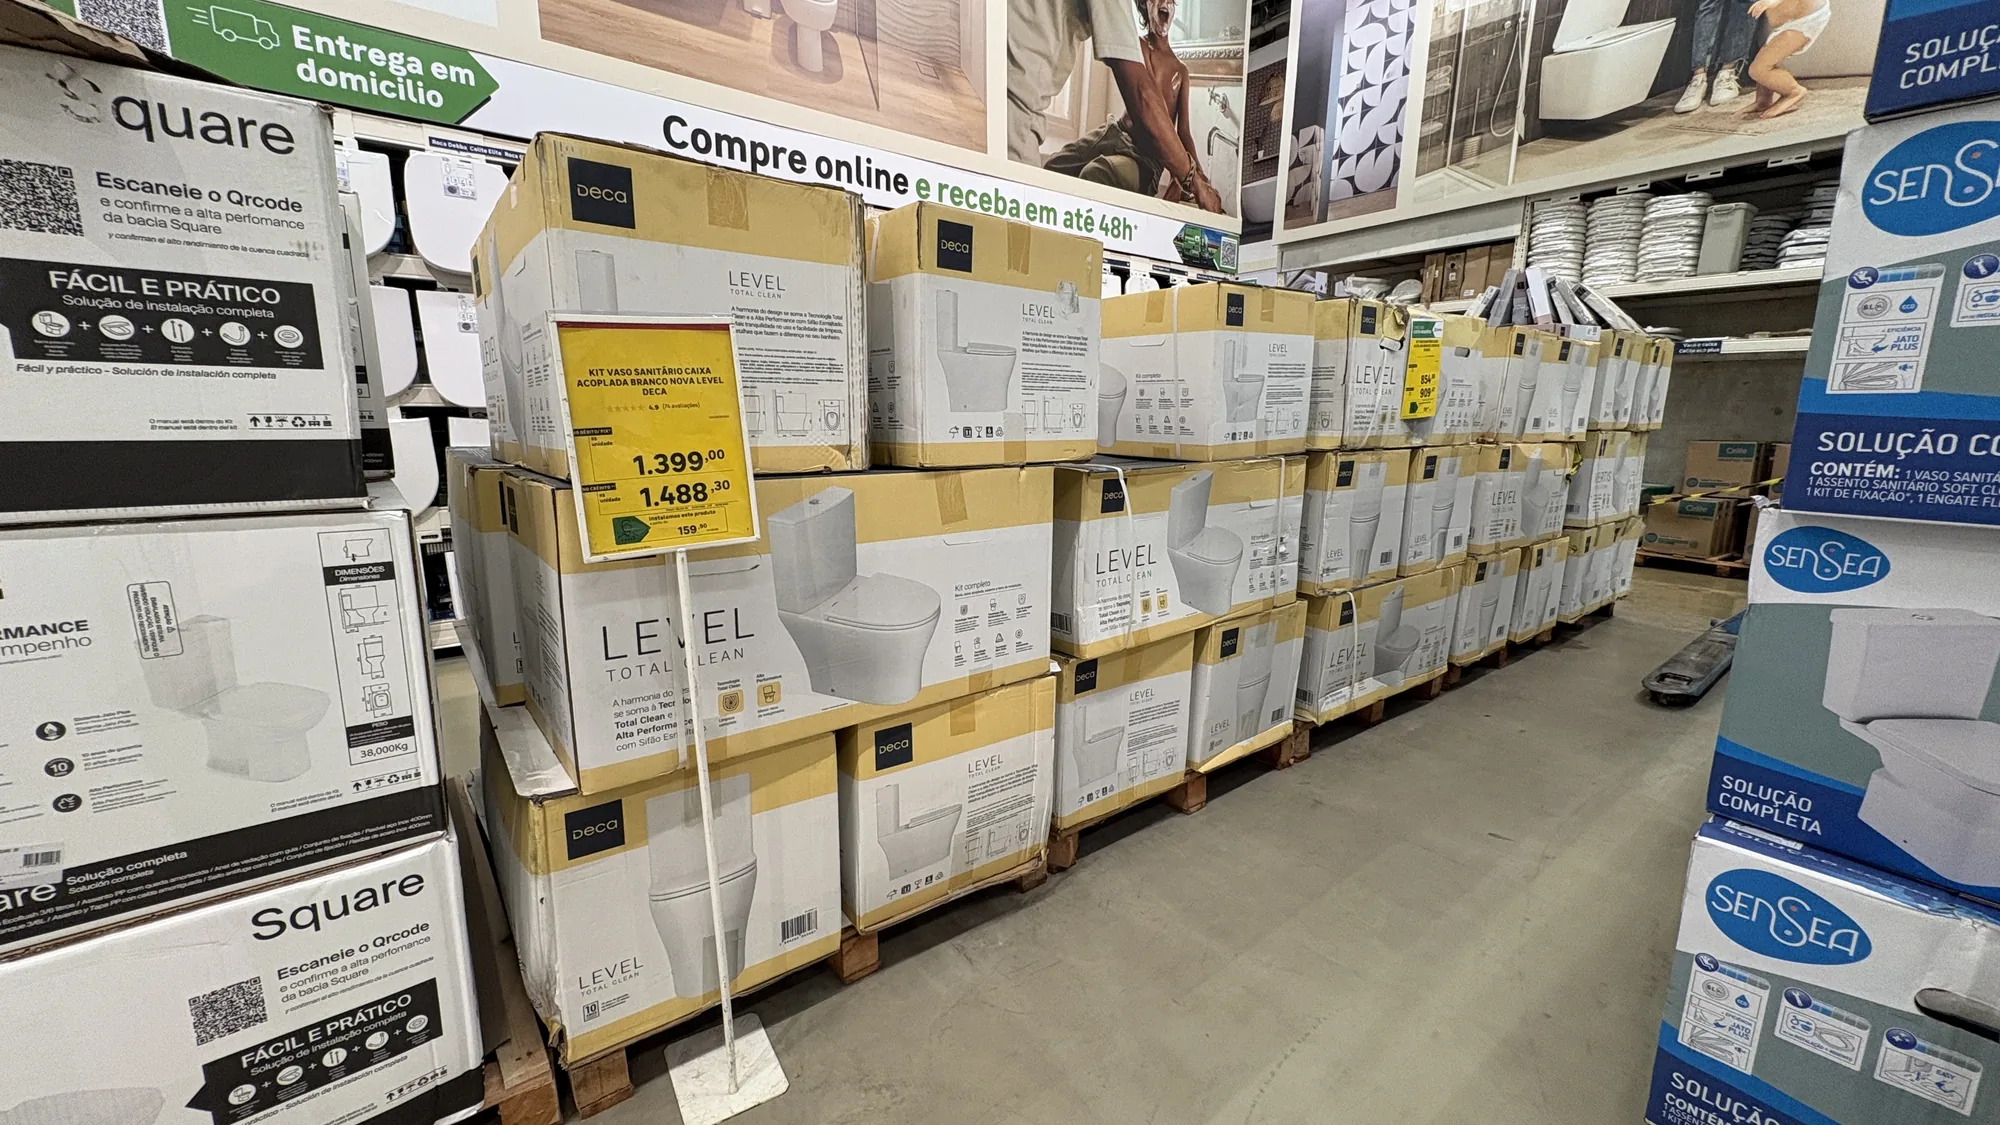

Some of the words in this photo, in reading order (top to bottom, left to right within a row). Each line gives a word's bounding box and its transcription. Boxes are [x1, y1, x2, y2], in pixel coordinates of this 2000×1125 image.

[1905, 24, 2000, 64] SOLUÇ
[291, 25, 424, 77] Entrega
[430, 61, 476, 87] em
[1900, 52, 2000, 89] COMPL
[432, 139, 447, 147] Roca
[505, 151, 519, 159] Roca
[662, 114, 807, 174] Compre
[815, 155, 910, 195] online
[915, 178, 931, 200] e
[938, 178, 1020, 220] receba
[1025, 201, 1058, 227] em
[1063, 207, 1095, 234] até
[96, 171, 203, 200] Escaneie
[208, 190, 222, 202] o
[227, 190, 303, 213] Qrcode
[576, 182, 628, 206] Deca
[100, 197, 111, 207] e
[114, 198, 181, 216] confirme
[184, 207, 194, 217] a
[196, 208, 222, 221] alta
[225, 211, 305, 230] perfomance
[103, 212, 123, 224] da
[127, 213, 168, 229] bacia
[170, 218, 222, 235] Square
[48, 269, 136, 296] FÁCIL
[140, 278, 160, 297] E
[166, 280, 281, 305] PRÁTICO
[729, 270, 786, 291] LEVEL
[730, 288, 754, 297] TOTAL
[758, 291, 782, 299] CLEAN
[62, 294, 122, 311] Solução
[125, 300, 144, 312] de
[146, 301, 214, 316] instalação
[216, 306, 275, 320] completa
[808, 312, 832, 320] Tecnologia
[1022, 303, 1055, 319] LEVEL
[1269, 343, 1288, 353] LEVEL
[1890, 343, 1918, 351] PLUS
[1894, 335, 1919, 343] JATO
[16, 363, 45, 374] Fácil
[46, 366, 54, 376] y
[56, 365, 103, 378] práctico
[112, 366, 159, 378] Solución
[160, 368, 175, 378] de
[176, 369, 231, 379] instalación
[232, 371, 277, 381] completa
[588, 368, 605, 377] KIT
[606, 367, 633, 376] VASO
[634, 365, 684, 376] SANITÁRIO
[685, 367, 712, 375] CAIXA
[577, 378, 629, 387] ACOPLADA
[630, 377, 669, 386] BRANCO
[669, 377, 695, 385] NOVA
[696, 376, 724, 385] LEVEL
[642, 387, 668, 396] DECA
[1817, 428, 1958, 460] SOLUÇÃO
[1810, 460, 1901, 479] CONTÉM:
[1905, 470, 1911, 480] 1
[1914, 470, 1950, 482] VASO
[1808, 476, 1813, 485] 1
[1816, 477, 1870, 489] ASSENTO
[1872, 479, 1940, 492] SANITÁRIO
[1941, 482, 1977, 495] SOFT
[1492, 490, 1517, 506] LEVEL
[1806, 486, 1811, 495] 1
[1813, 487, 1832, 498] KIT
[1834, 488, 1850, 499] DE
[1917, 494, 1923, 503] 1
[1925, 493, 1979, 506] ENGATE
[694, 509, 716, 517] produto
[1096, 544, 1157, 575] LEVEL
[1326, 548, 1343, 559] LEVEL
[1768, 540, 1882, 581] SENSEA
[335, 566, 386, 576] DIMENSÕES
[339, 574, 380, 583] Dimensiones
[1096, 577, 1123, 588] TOTAL
[1126, 570, 1152, 582] CEAN
[955, 584, 963, 592] Kit
[964, 580, 991, 590] completo
[605, 660, 673, 683] TOTAL
[612, 699, 620, 708] A
[621, 693, 661, 707] harmonia
[662, 689, 674, 698] do
[1130, 688, 1155, 702] LEVEL
[614, 718, 638, 730] Total
[640, 713, 666, 725] Clean
[667, 711, 673, 719] e
[1210, 719, 1230, 734] LEVEL
[616, 731, 635, 741] Alta
[360, 743, 409, 759] 38,000Kg
[50, 762, 68, 774] 10
[968, 754, 1003, 773] LEVEL
[1721, 775, 1812, 812] SOLUÇÃO
[1718, 792, 1822, 836] COMPLETA
[571, 818, 619, 842] Deca
[66, 867, 124, 886] Solução
[126, 851, 188, 872] completa
[68, 879, 110, 895] Solución
[111, 869, 154, 886] completa
[251, 873, 425, 941] Square
[1711, 884, 1860, 957] SENSEA
[277, 948, 355, 981] Escaneie
[358, 943, 369, 953] o
[373, 922, 430, 948] Qrcode
[579, 957, 644, 990] LEVEL
[581, 984, 608, 997] TOTAL
[612, 972, 640, 986] CLEAN
[585, 1004, 597, 1014] 10
[240, 1036, 305, 1069] FÁCIL
[308, 1027, 323, 1043] E
[325, 994, 412, 1037] PRÁTICO
[1728, 1027, 1750, 1041] PLUS
[1730, 1022, 1751, 1034] JATO
[1936, 1069, 1957, 1080] EASY
